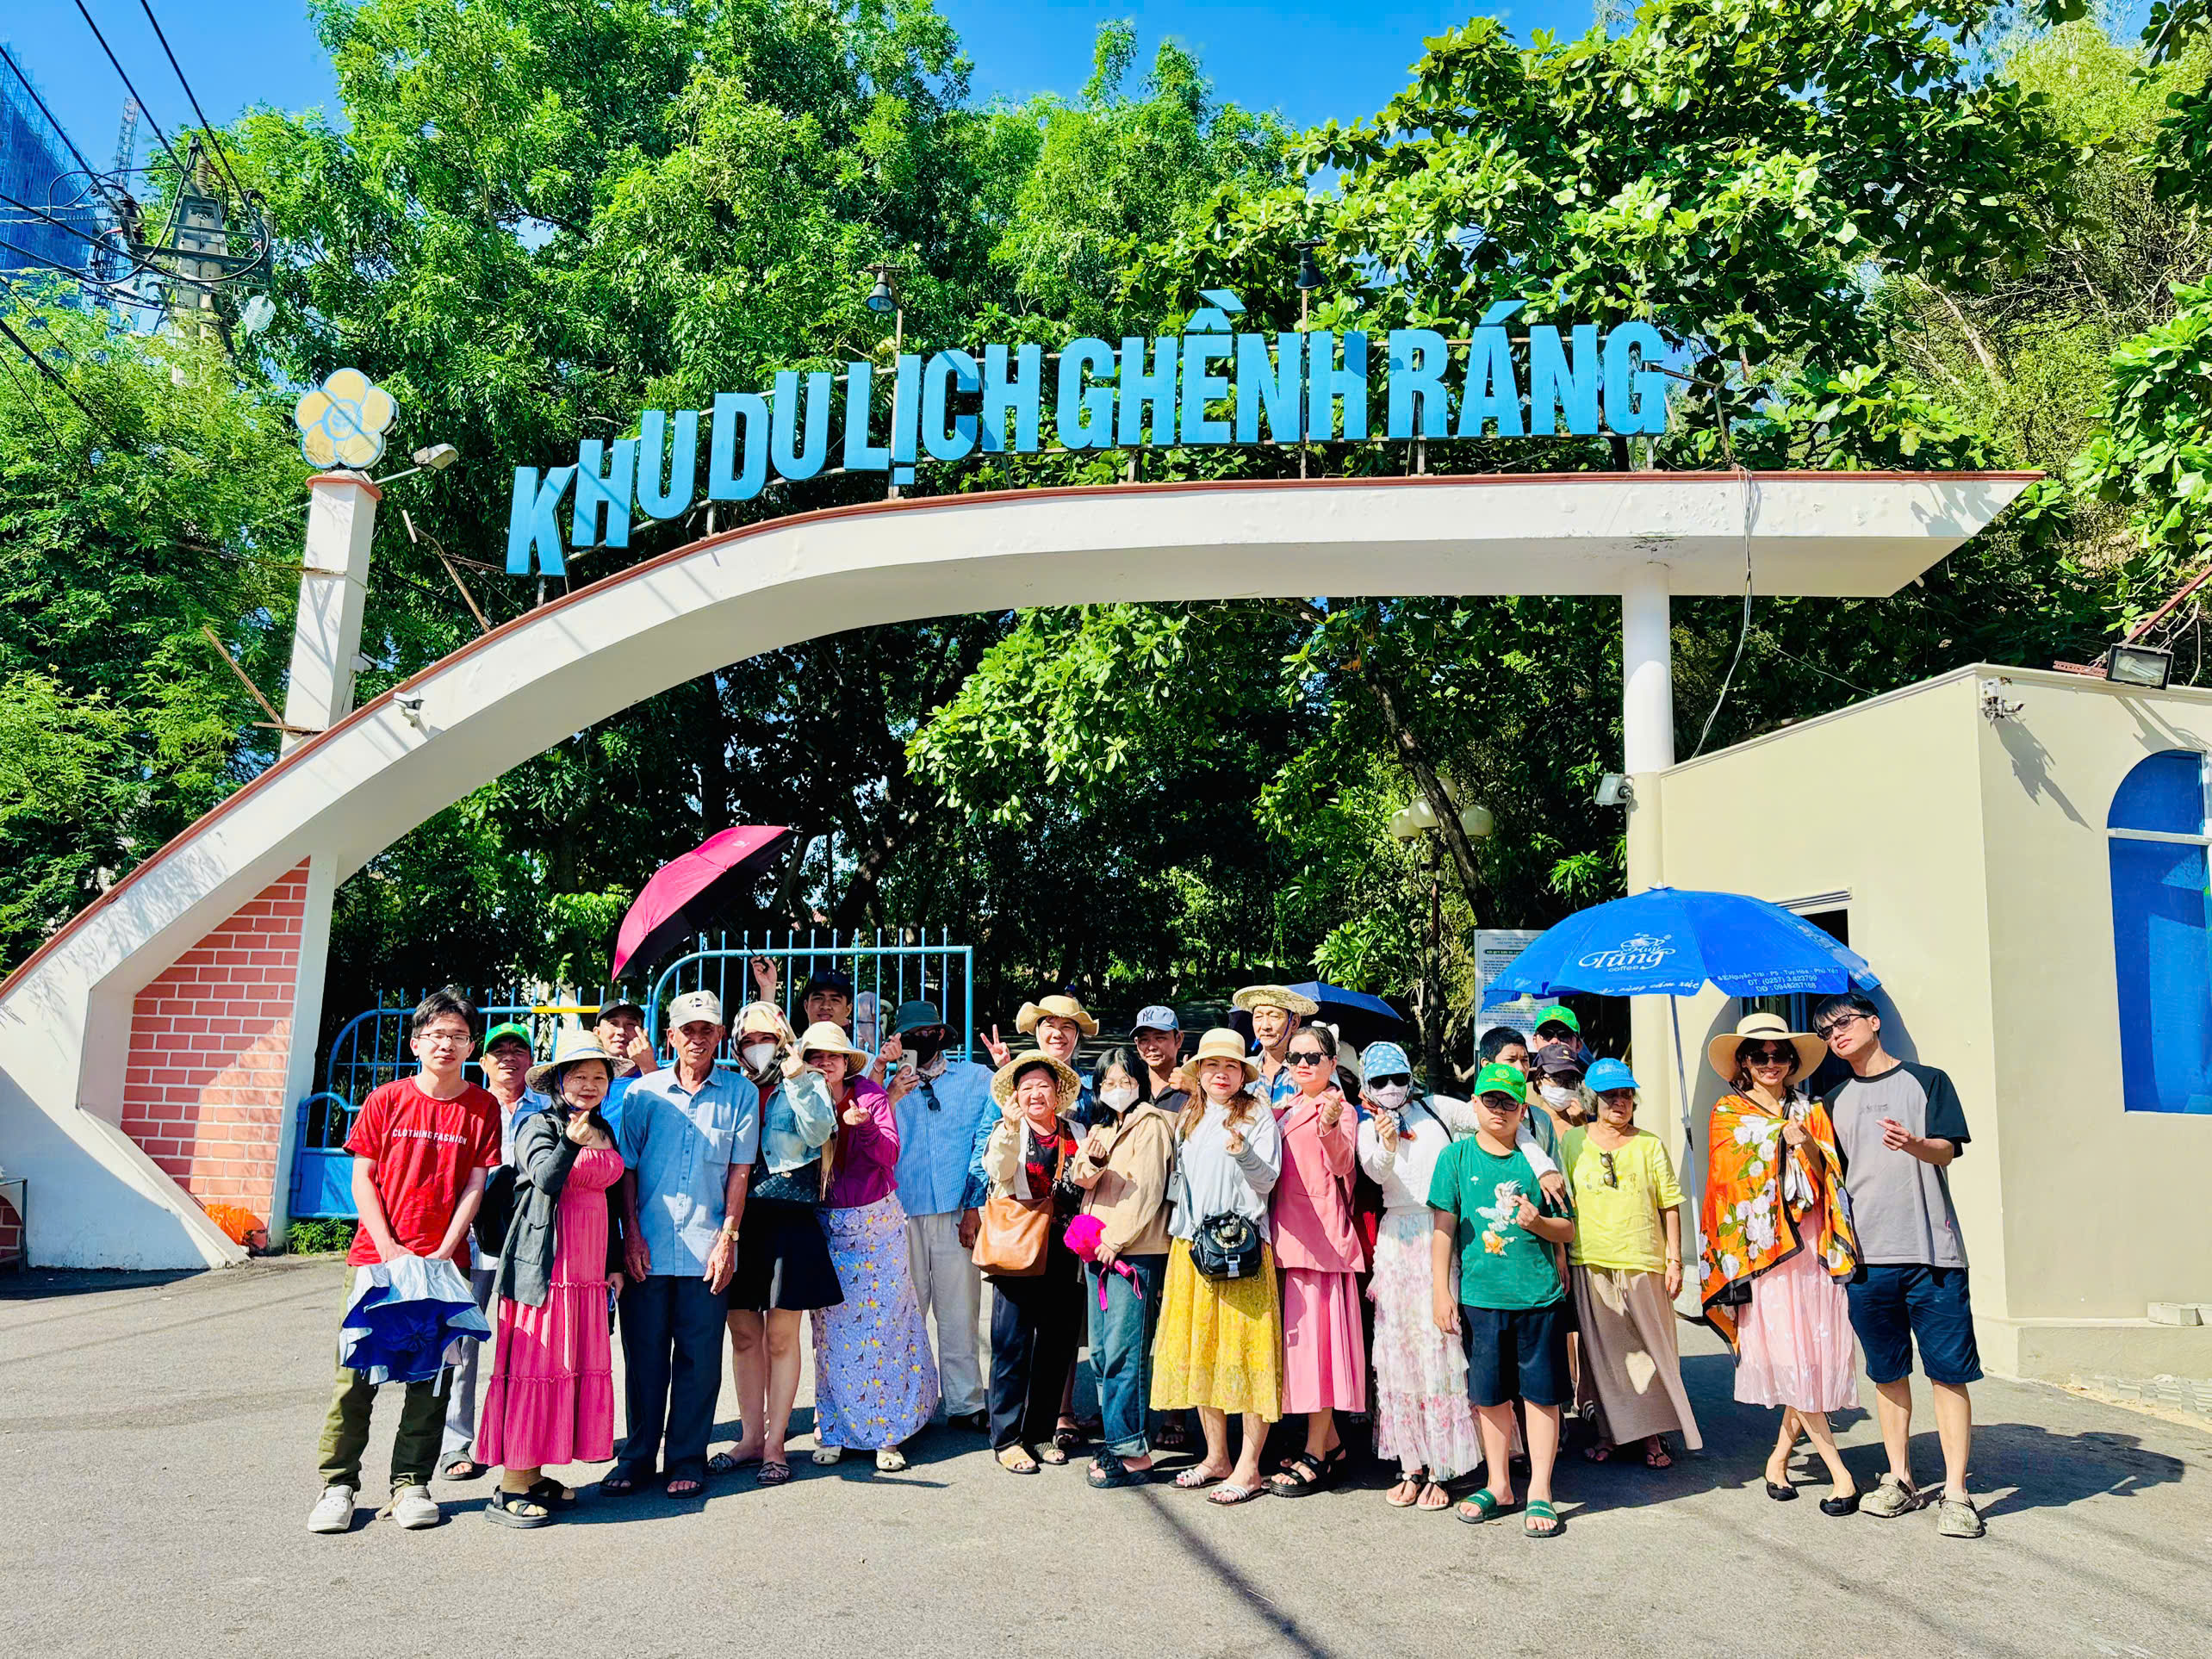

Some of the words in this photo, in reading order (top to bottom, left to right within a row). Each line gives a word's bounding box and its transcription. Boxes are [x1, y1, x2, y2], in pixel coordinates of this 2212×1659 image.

[506, 410, 698, 576] KHU
[709, 371, 834, 501] DU
[843, 344, 1041, 484] LỊCH
[1056, 289, 1368, 450] GHỀNH
[1388, 299, 1665, 438] RÁNG
[1142, 1009, 1154, 1022] NY
[392, 1128, 432, 1139] CLOTHING
[432, 1132, 468, 1146] FASHION
